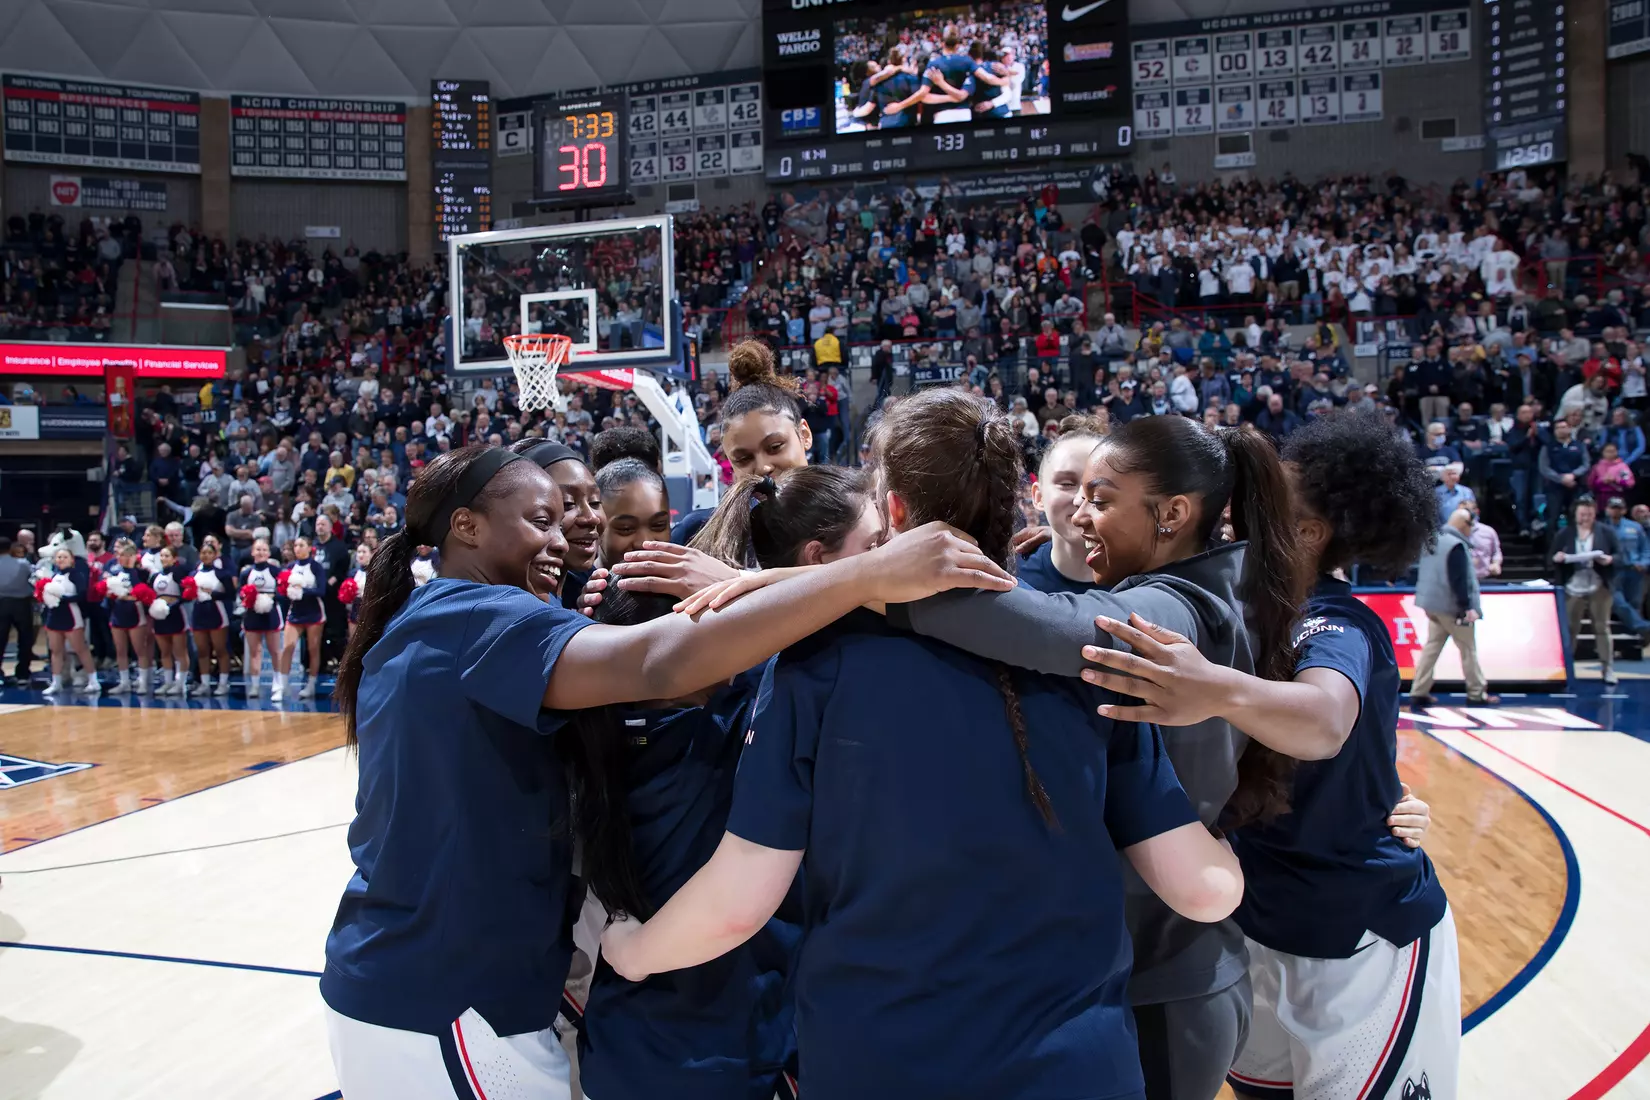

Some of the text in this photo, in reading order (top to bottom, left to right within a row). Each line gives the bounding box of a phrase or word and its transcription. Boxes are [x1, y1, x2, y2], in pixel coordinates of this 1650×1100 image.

[1202, 2, 1390, 30] UCONN HUSKIES OF HONOR
[776, 29, 820, 45] WELLS
[1440, 32, 1459, 51] 50
[778, 41, 820, 56] FARGO
[1304, 45, 1332, 64] 42
[1220, 53, 1247, 72] 00
[1263, 49, 1287, 67] 13
[1138, 61, 1164, 79] 52
[12, 78, 190, 102] NATIONAL INVITATION TOURNAMENT
[643, 82, 656, 91] OF
[662, 77, 699, 89] HONOR
[241, 96, 396, 113] NCAA CHAMPIONSHIP
[1063, 89, 1109, 102] TRAVELERS
[733, 102, 758, 119] 42
[1268, 100, 1285, 118] 42
[1311, 96, 1328, 114] 13
[240, 108, 398, 122] TOURNAMENT APPEARANCES
[631, 114, 655, 132] 42
[664, 110, 688, 128] 44
[781, 107, 816, 123] CBS
[1186, 107, 1201, 125] 22
[565, 111, 614, 139] 7:33
[505, 131, 519, 147] C
[933, 133, 965, 151] 7:33
[1117, 125, 1132, 146] 0
[700, 152, 722, 170] 22
[1010, 147, 1018, 159] 0
[558, 141, 607, 190] 30
[631, 159, 656, 176] 24
[667, 156, 686, 172] 13
[780, 156, 793, 176] 0
[831, 163, 838, 175] 3
[873, 159, 881, 171] 0
[57, 186, 76, 197] NIT
[965, 185, 1005, 197] Basketball
[5, 355, 51, 365] Insurance
[57, 356, 101, 369] Employee
[144, 359, 182, 369] Financial
[183, 360, 219, 370] Services
[915, 370, 933, 380] SEC
[1293, 624, 1344, 649] UCONN
